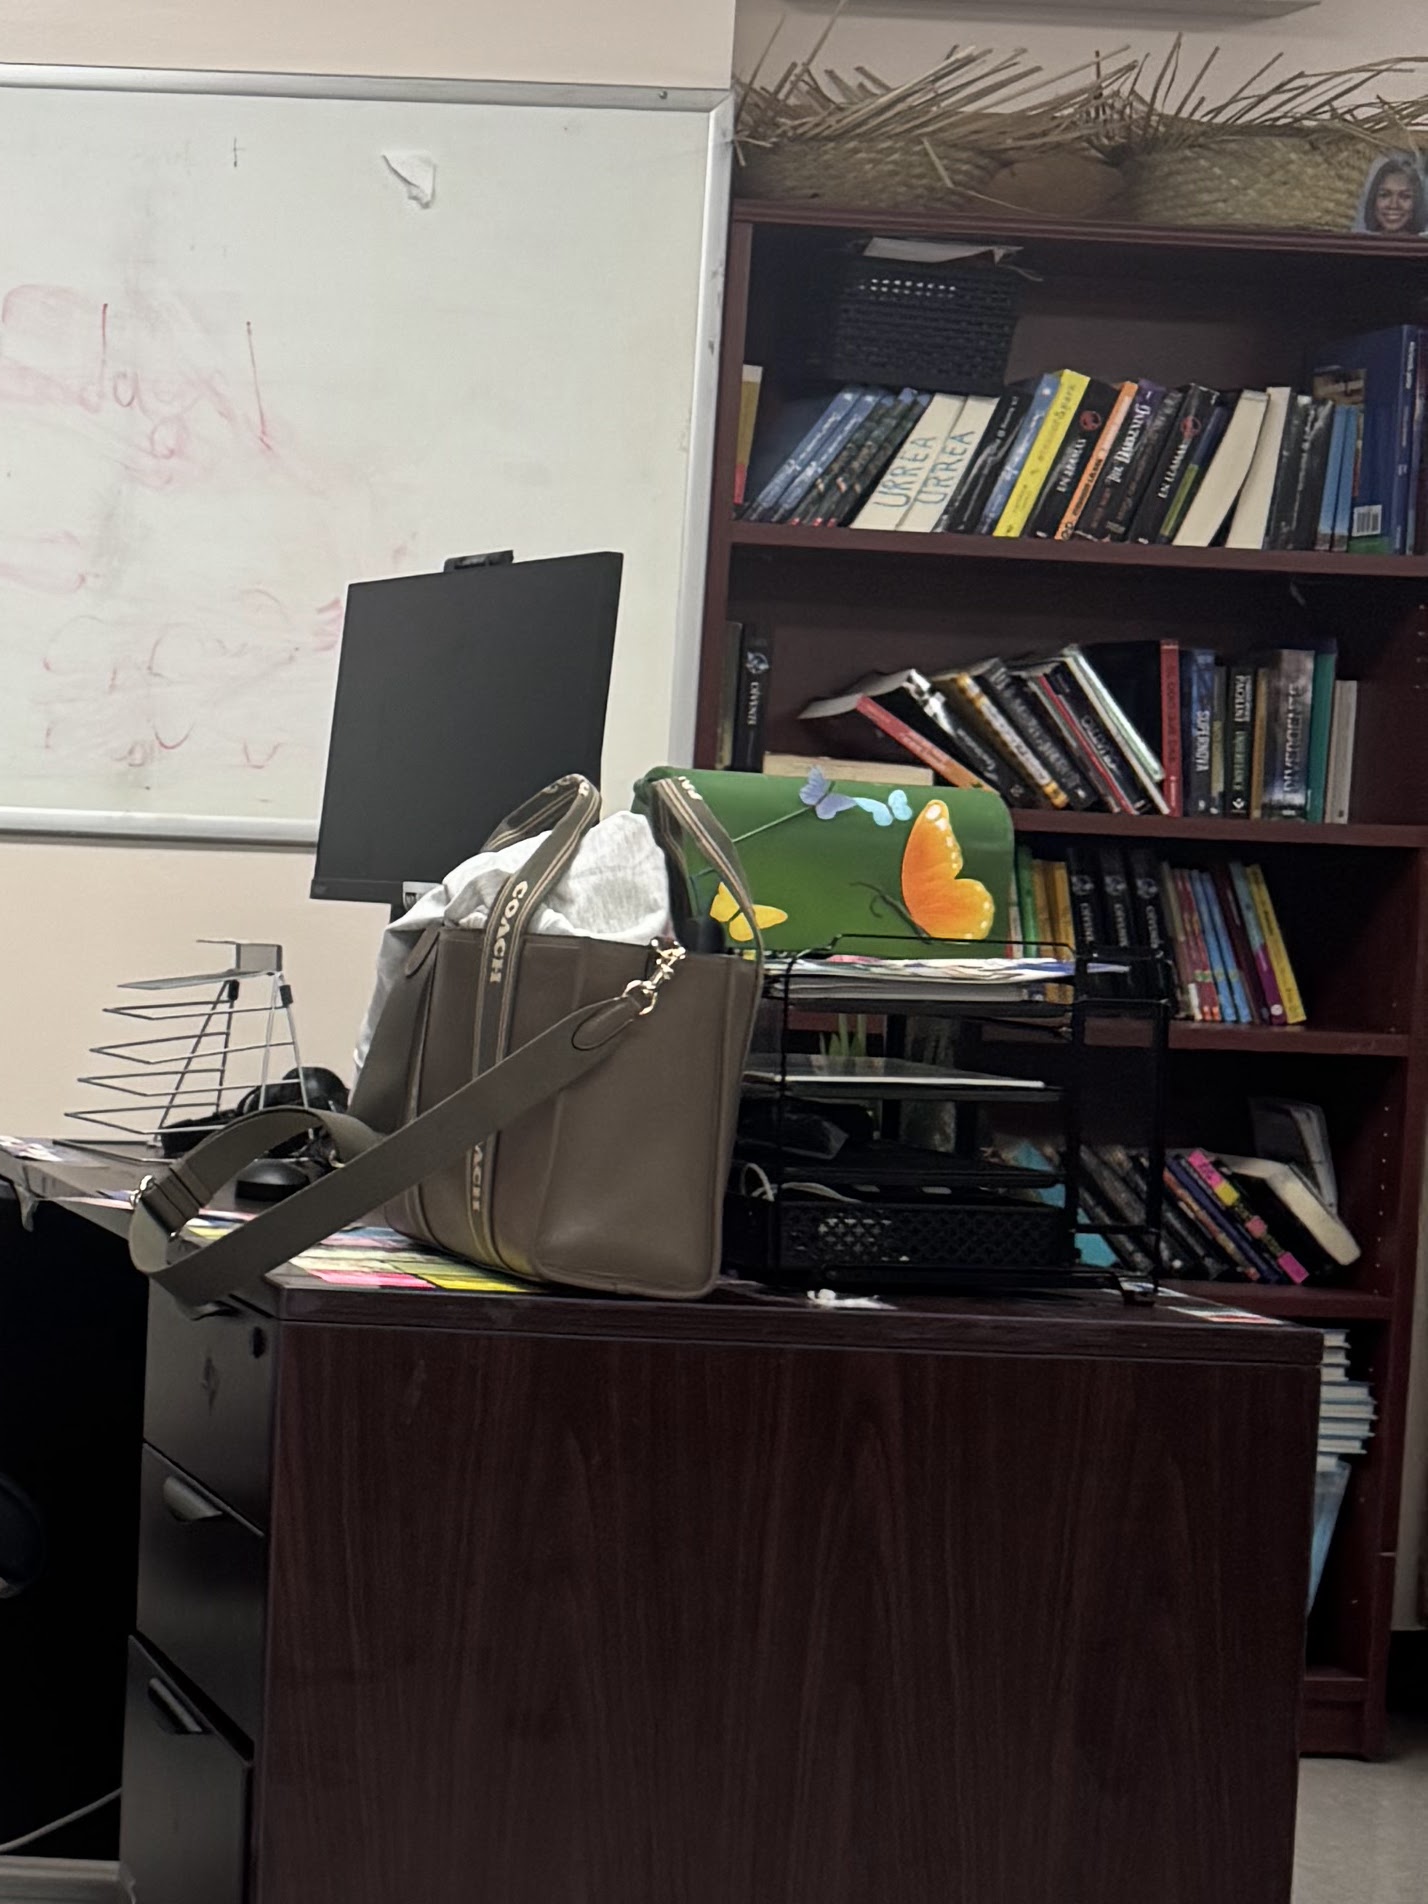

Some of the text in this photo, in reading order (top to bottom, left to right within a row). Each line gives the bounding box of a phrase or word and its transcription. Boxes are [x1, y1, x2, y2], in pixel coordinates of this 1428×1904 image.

[1234, 675, 1245, 723] PAOLINI
[1195, 709, 1211, 773] SUPERNOVA
[489, 880, 529, 983] COACH
[471, 1141, 484, 1212] ACH
